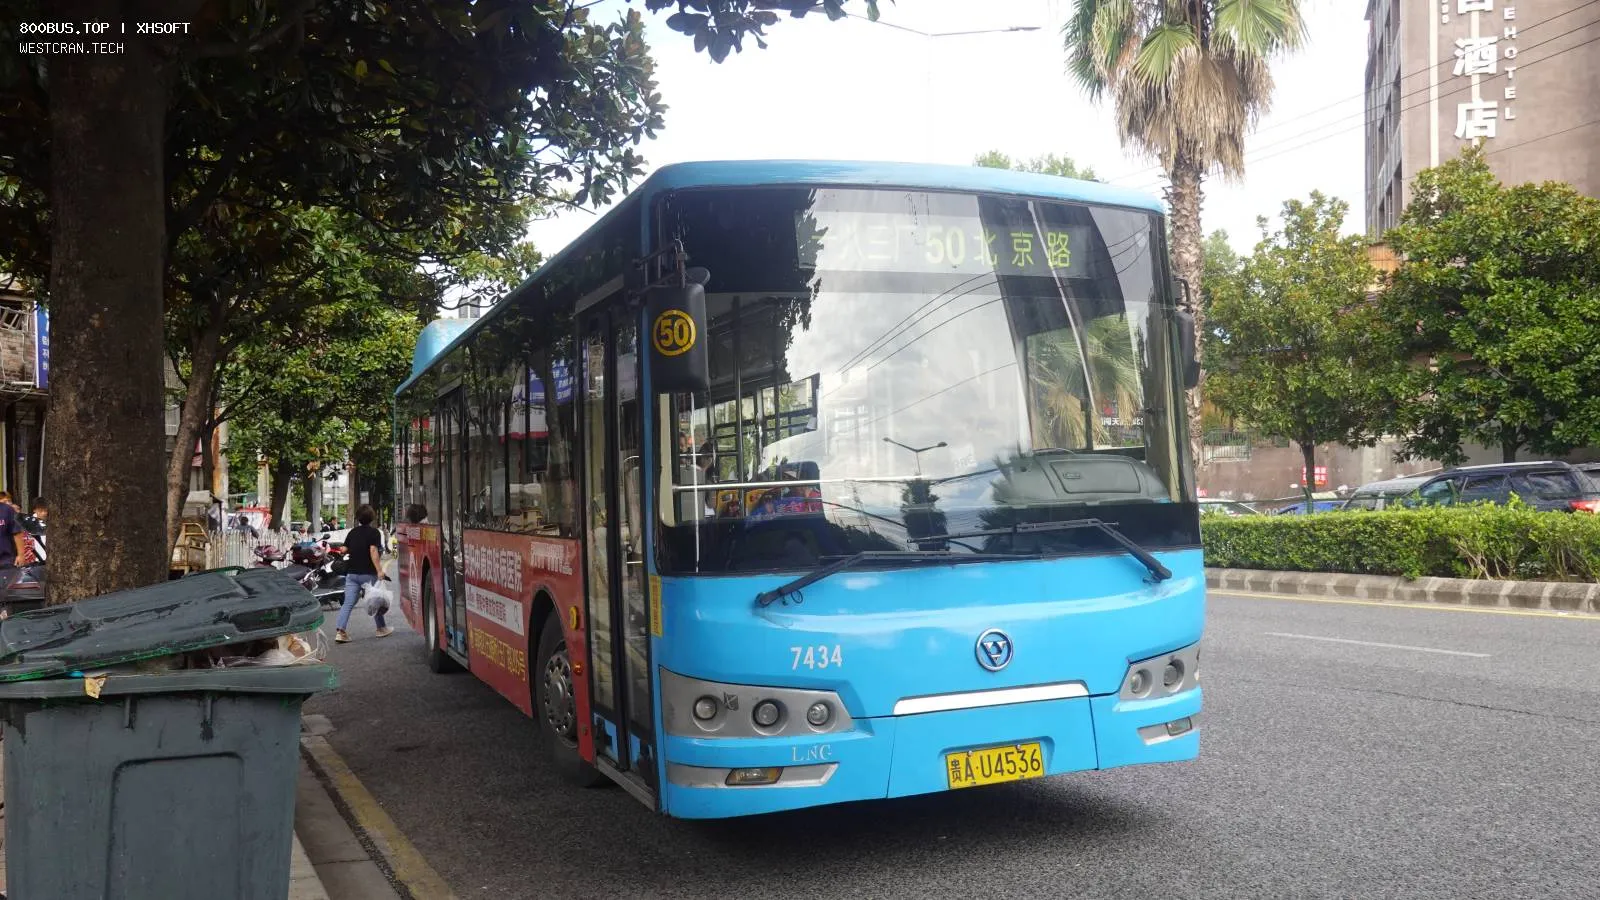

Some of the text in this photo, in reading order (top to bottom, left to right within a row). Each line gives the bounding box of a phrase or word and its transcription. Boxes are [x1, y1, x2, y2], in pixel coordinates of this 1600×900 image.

[925, 226, 965, 265] 50
[973, 227, 1072, 268] 北京路
[660, 318, 689, 347] 50
[790, 644, 843, 670] 7434
[792, 744, 832, 761] LNG
